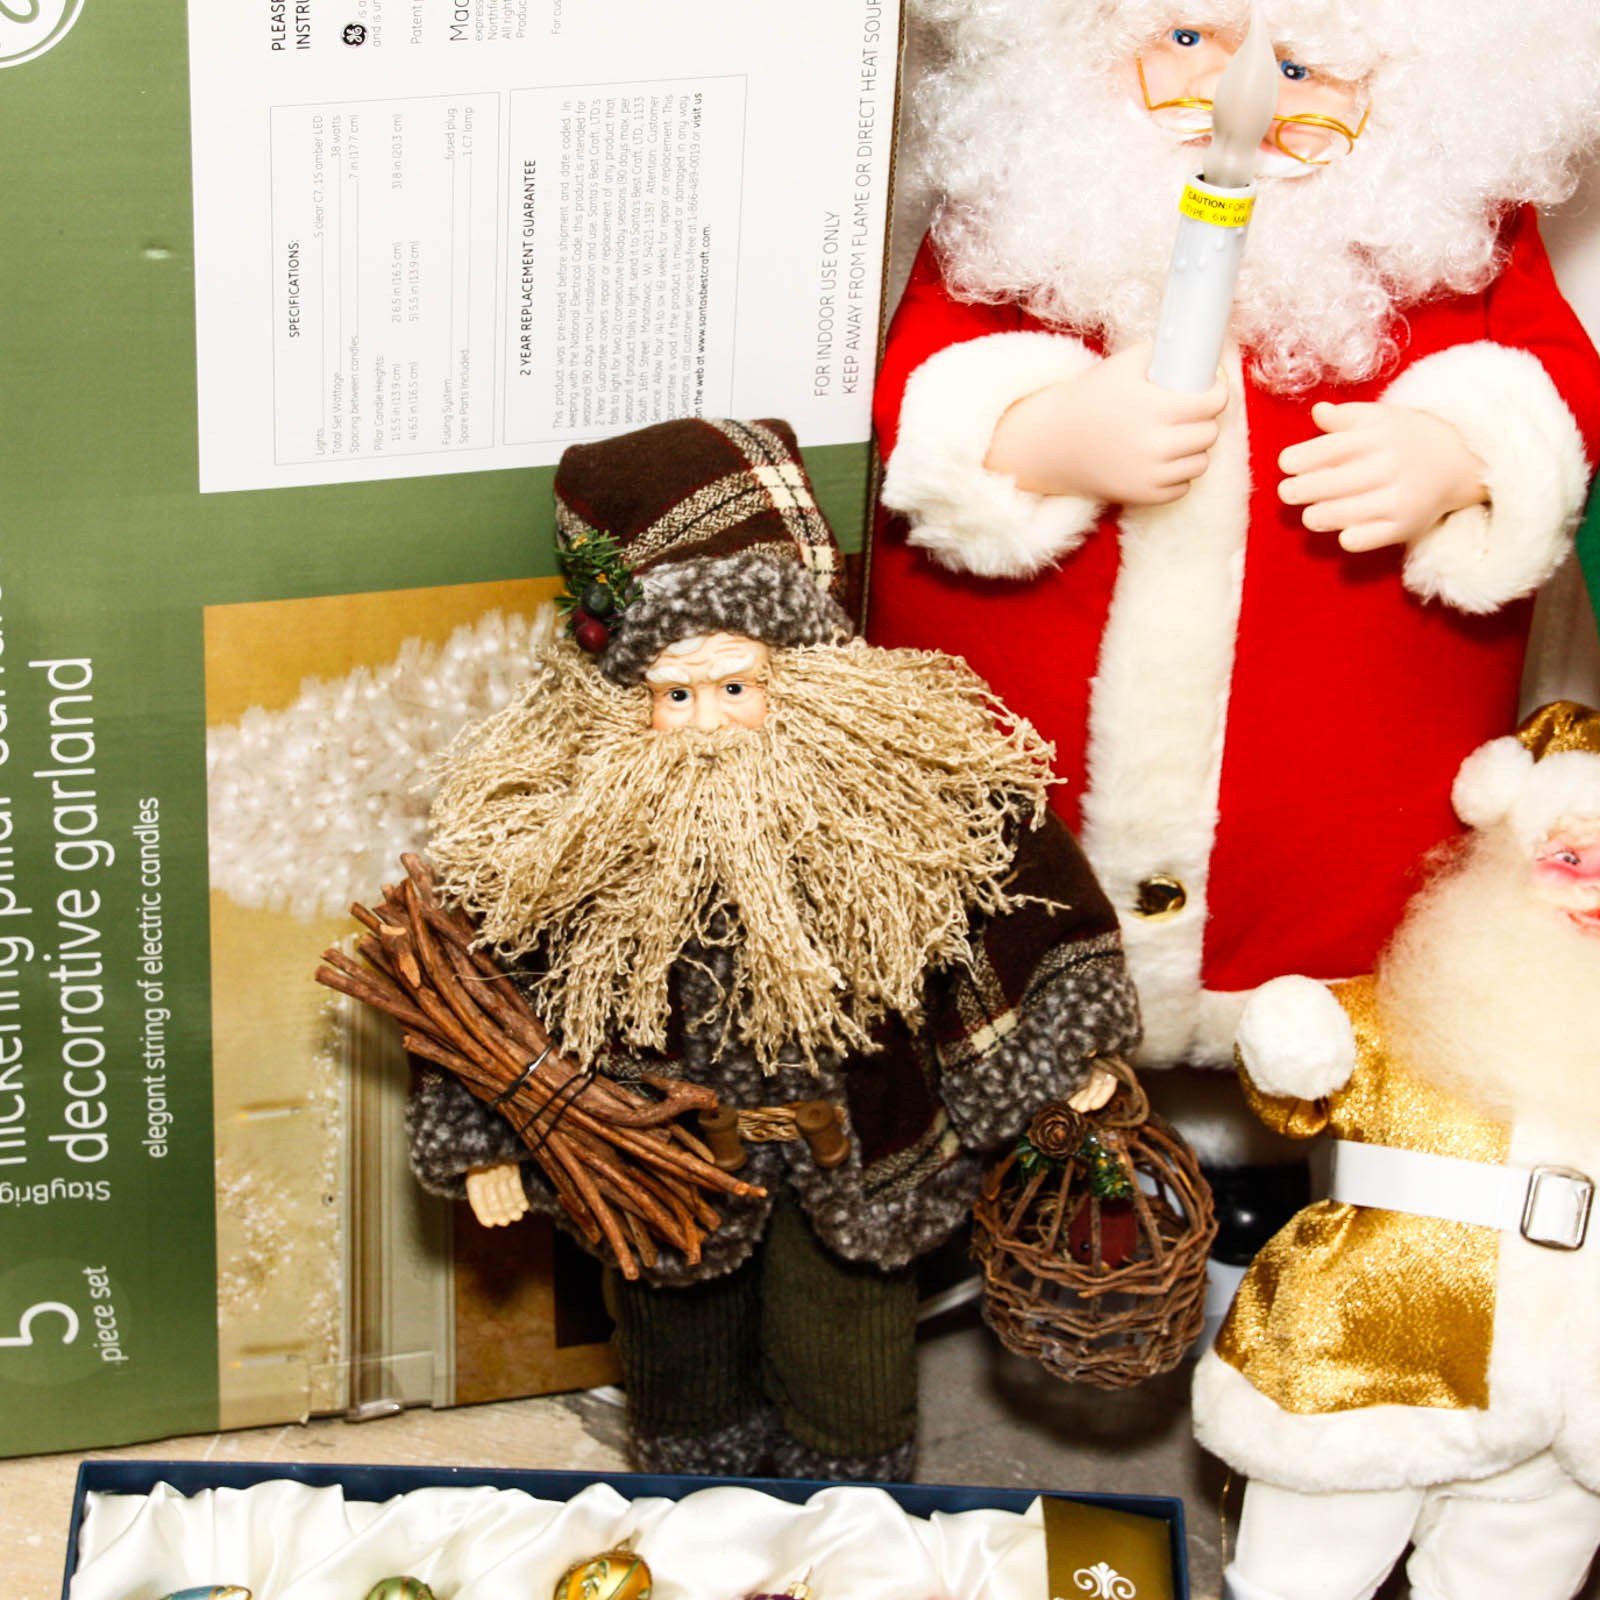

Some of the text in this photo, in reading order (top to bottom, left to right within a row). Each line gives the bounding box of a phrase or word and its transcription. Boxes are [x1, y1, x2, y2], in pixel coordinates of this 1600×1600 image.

[410, 4, 423, 44] Patent
[860, 48, 879, 92] HEAT
[693, 92, 702, 105] us
[312, 115, 322, 136] LED
[690, 107, 701, 129] visit
[856, 97, 876, 158] DIRECT
[312, 137, 322, 171] amber
[559, 155, 569, 177] date
[558, 182, 568, 201] and
[854, 162, 871, 187] OR
[313, 206, 323, 231] clear
[557, 207, 570, 252] shipment
[851, 191, 871, 246] FLAME
[522, 159, 536, 377] 2 YEAR REPLACEMENT GUARANTEE
[556, 256, 566, 288] before
[848, 252, 867, 300] FROM
[289, 240, 300, 339] SPECIFICATIONS:
[814, 212, 840, 396] FOR INDOOR USE ONLY
[844, 304, 863, 351] AWAY
[556, 346, 564, 365] was
[695, 356, 704, 366] at
[842, 355, 860, 394] KEEP
[553, 370, 566, 407] product
[693, 367, 704, 388] web
[693, 389, 703, 405] the
[552, 411, 562, 429] This
[28, 658, 116, 1164] decorative garland
[132, 796, 174, 1158] elegant string of electric candles
[0, 1301, 80, 1348] 5
[82, 1265, 128, 1362] piece set
